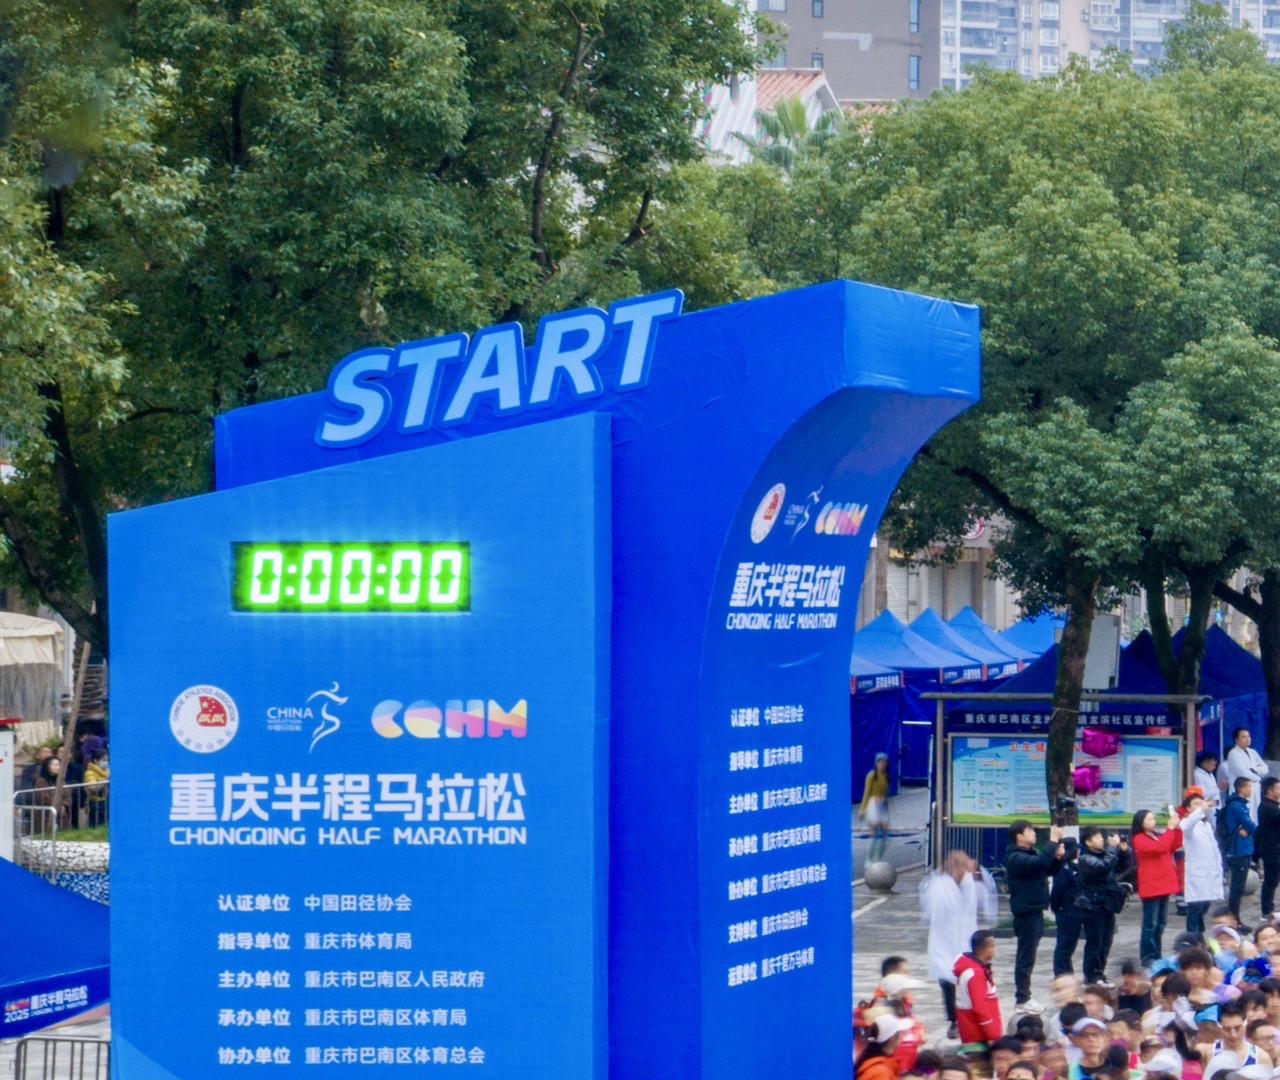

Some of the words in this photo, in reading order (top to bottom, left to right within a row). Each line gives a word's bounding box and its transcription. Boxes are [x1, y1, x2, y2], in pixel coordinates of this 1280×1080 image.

[320, 296, 678, 443] START
[251, 550, 462, 604] 0:00:00
[730, 563, 845, 607] 重庆半程马拉松
[726, 613, 771, 629] CHONGQING
[774, 613, 795, 629] HALF
[797, 613, 838, 629] MARATHON
[267, 707, 313, 719] CHINA
[371, 699, 527, 738] CQHM
[169, 772, 526, 821] 重庆半程马拉松
[169, 827, 306, 845] CHONGQING
[319, 827, 381, 845] HALF
[394, 827, 527, 845] MARATHON
[218, 895, 290, 911] 认证单位
[305, 894, 411, 911] 中国田径协会
[218, 933, 289, 950] 指导单位
[305, 932, 412, 949] 重庆市体育局
[219, 971, 290, 988] 主办单位
[305, 970, 484, 988] 重庆市巴南区人民政府
[219, 1009, 290, 1026] 承办单位
[305, 1009, 466, 1026] 重庆市巴南区体育局
[219, 1047, 290, 1064] 协办单位
[306, 1047, 485, 1064] 重庆市巴南区体育总会
